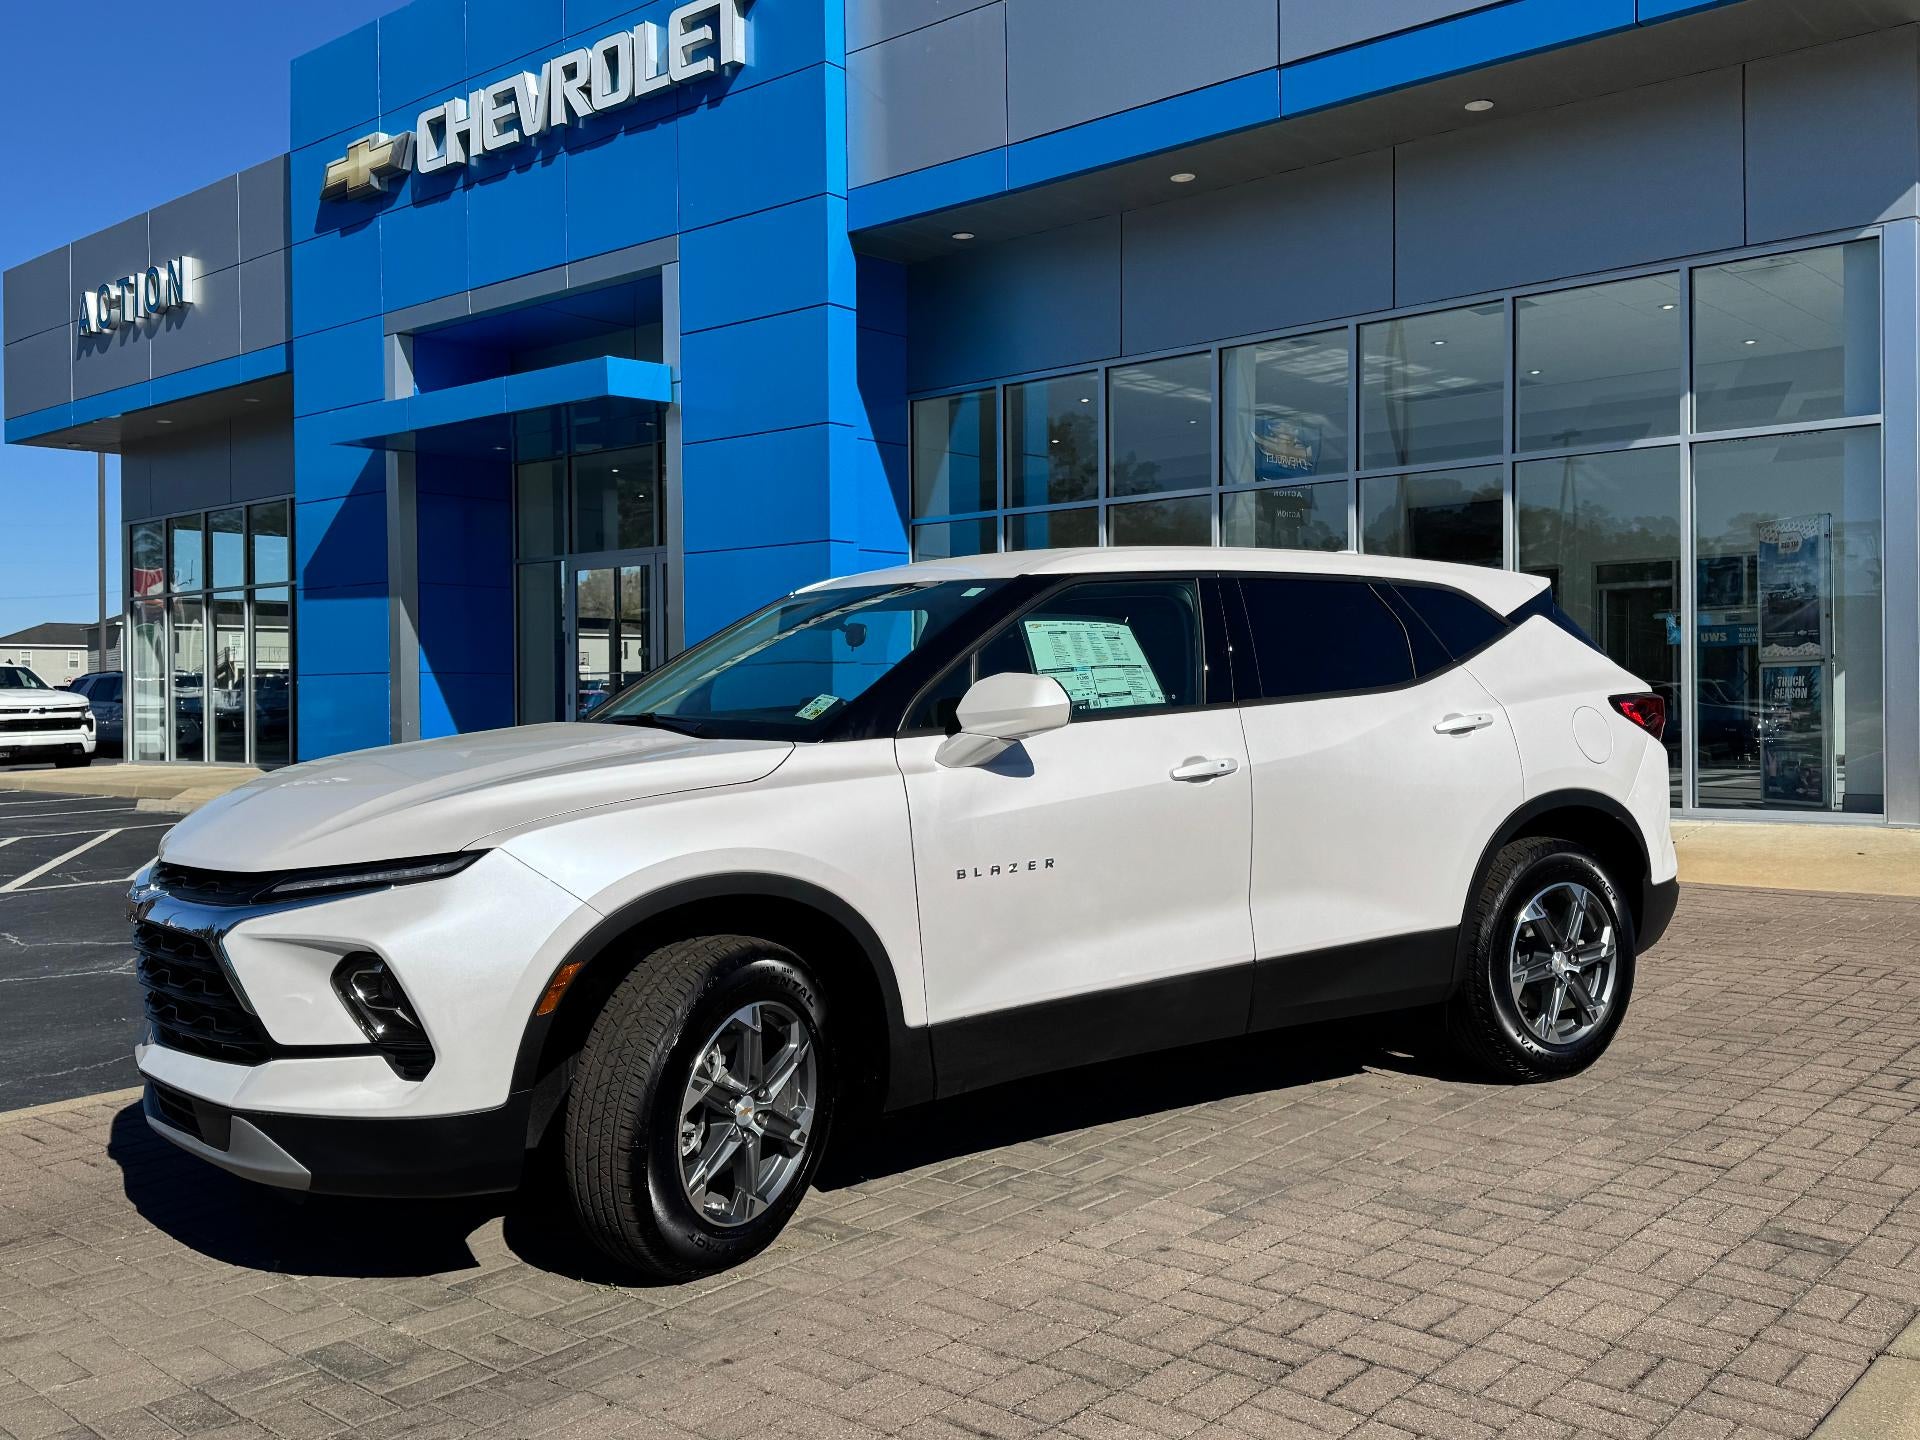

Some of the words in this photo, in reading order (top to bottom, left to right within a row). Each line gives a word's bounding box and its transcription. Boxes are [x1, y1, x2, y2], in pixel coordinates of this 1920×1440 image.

[417, 0, 746, 173] CHEVROLET
[79, 256, 192, 336] ACTION
[1700, 632, 1728, 642] UWS
[1777, 675, 1805, 687] TRUCK
[1774, 687, 1808, 699] SEASON
[957, 858, 1054, 879] BLAZER
